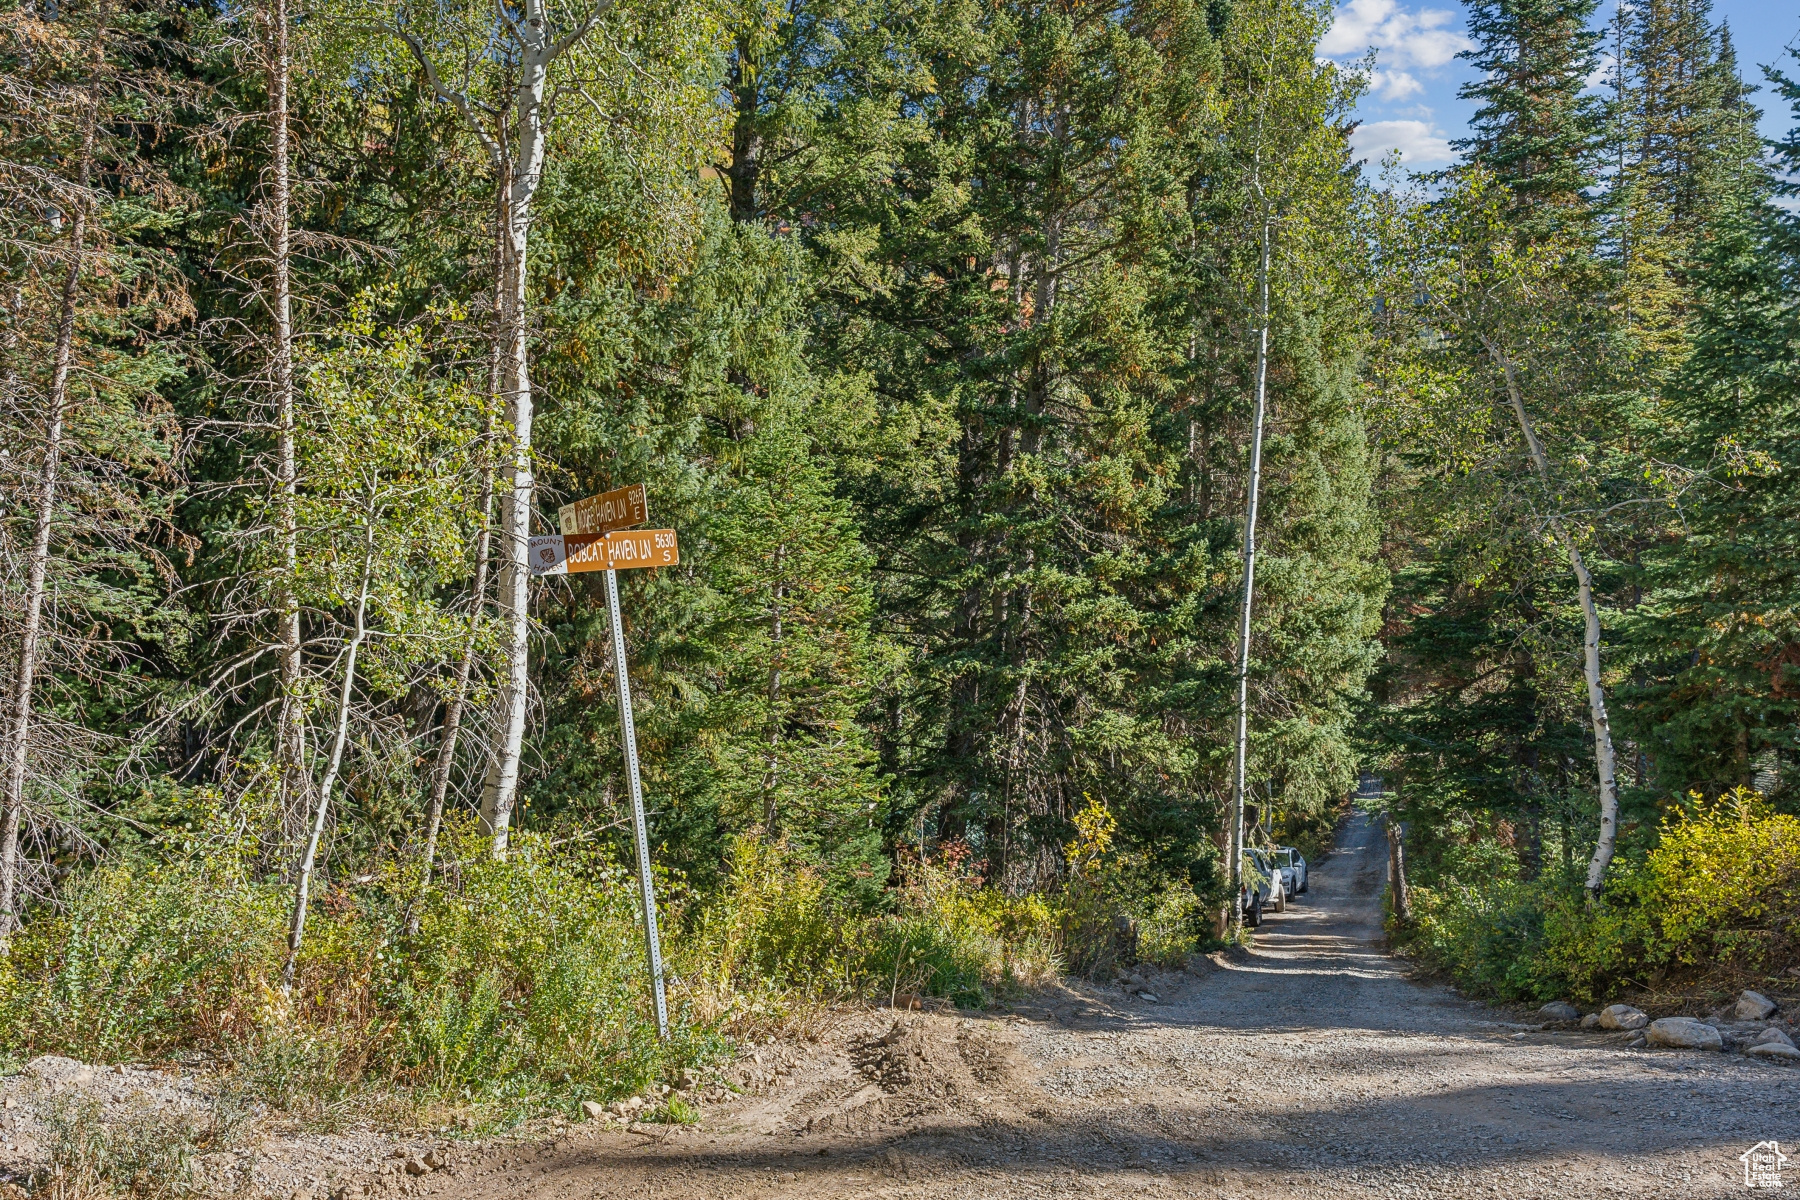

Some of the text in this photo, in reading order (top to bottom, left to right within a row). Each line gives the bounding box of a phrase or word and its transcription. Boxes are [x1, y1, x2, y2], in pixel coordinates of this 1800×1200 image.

[628, 488, 643, 506] 9265
[596, 501, 616, 525] HAVEN
[617, 498, 627, 519] LN
[634, 506, 641, 520] E
[530, 538, 563, 548] MOUNT
[655, 533, 674, 549] 5630
[568, 539, 652, 564] BOBCAT HAVEN LN
[663, 550, 672, 562] S
[533, 563, 563, 573] HAVEN
